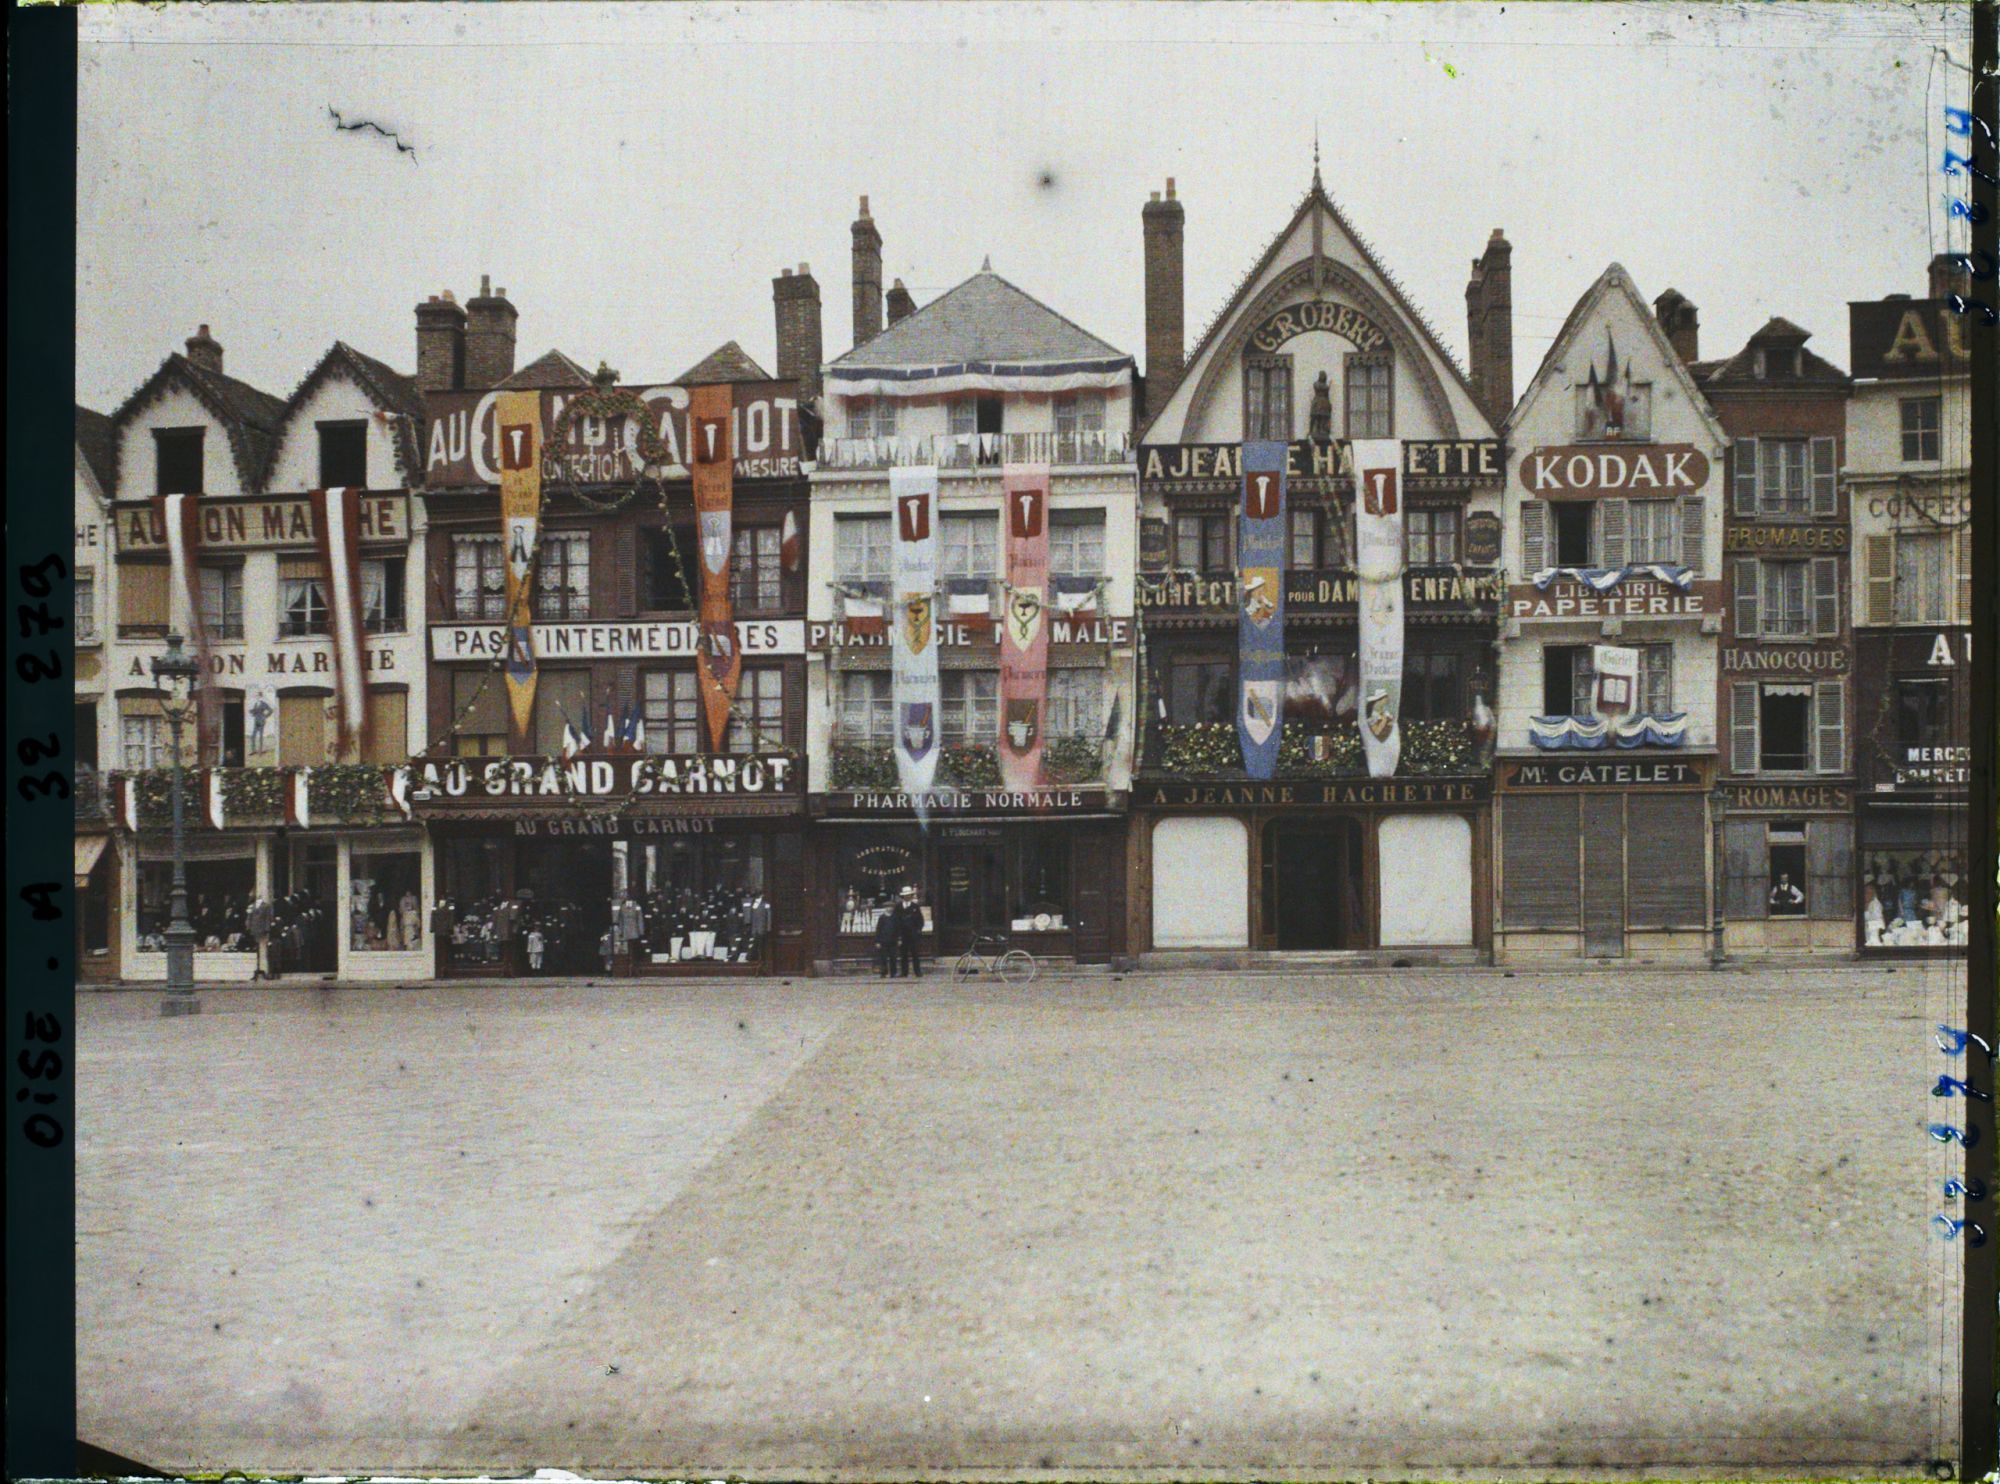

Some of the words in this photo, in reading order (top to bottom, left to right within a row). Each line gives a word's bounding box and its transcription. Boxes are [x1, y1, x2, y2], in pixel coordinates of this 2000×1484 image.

[427, 410, 467, 472] AU
[733, 456, 798, 478] MESURE
[1145, 448, 1164, 478] A
[1169, 446, 1301, 477] JEAE
[1313, 443, 1498, 475] HAETTE
[1535, 453, 1696, 490] KODAK
[205, 507, 246, 542] ON
[1727, 528, 1846, 547] FROMAGES
[1288, 592, 1315, 603] POUR
[1514, 595, 1704, 616] PAPETERIE
[207, 654, 246, 675] ON
[1723, 648, 1845, 672] HANOCQUE
[421, 763, 467, 796] AU
[484, 761, 614, 796] GRAND
[631, 757, 790, 793] CARNOT
[1559, 764, 1688, 783] GATELET
[853, 793, 971, 808] PHARMACIE
[986, 791, 1082, 808] NORMALE
[1154, 788, 1167, 803] A
[1185, 787, 1294, 804] JEANNE
[1323, 785, 1474, 802] HACHETTE
[1723, 786, 1848, 807] FROMAGES
[515, 820, 537, 836] AU
[548, 818, 619, 836] GRAND
[633, 818, 716, 835] CARNOT
